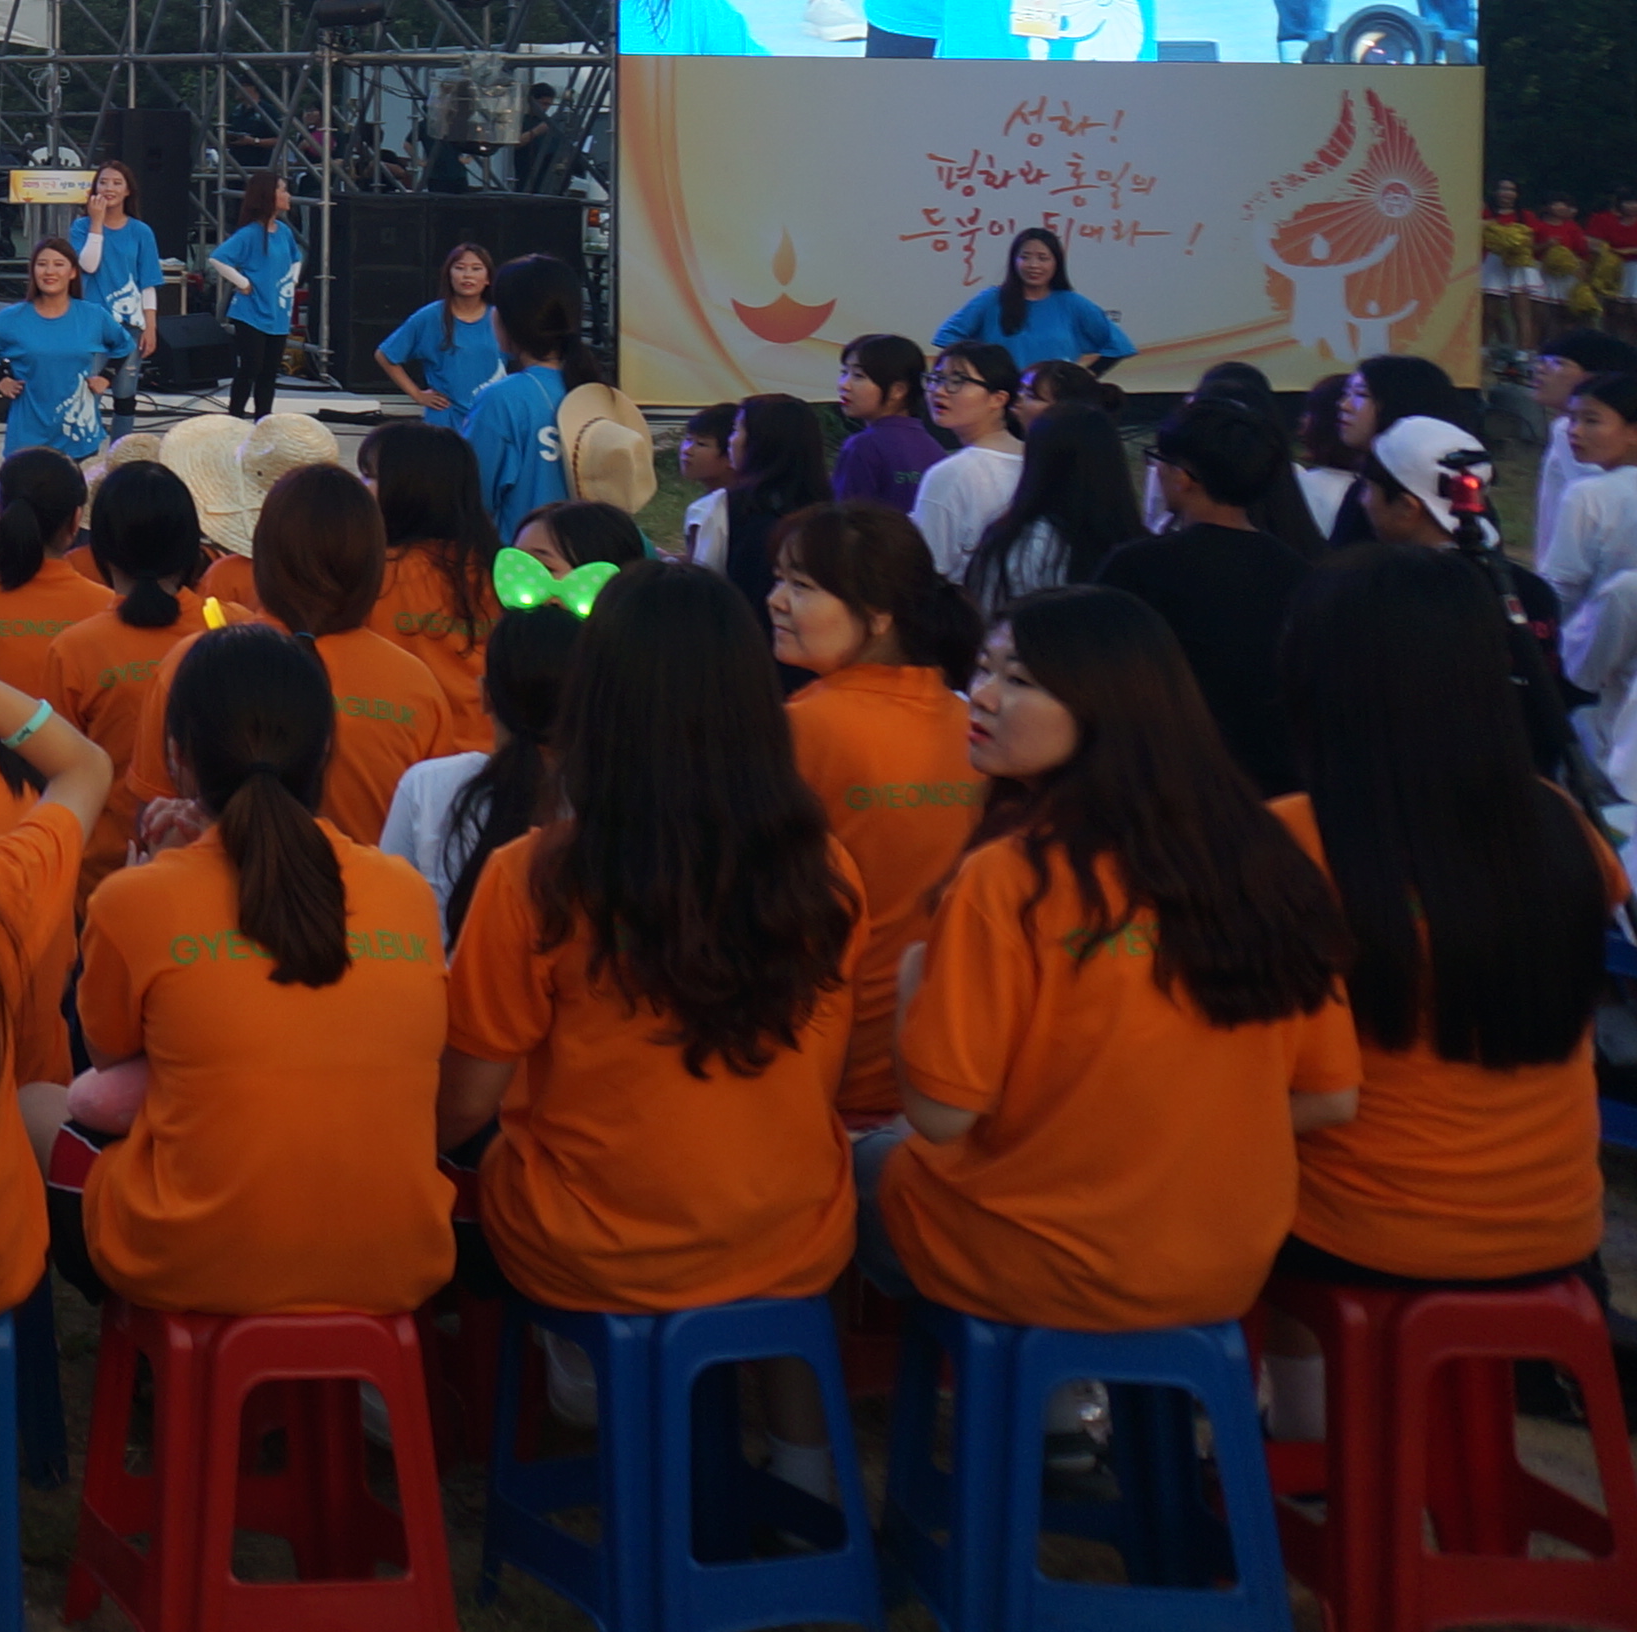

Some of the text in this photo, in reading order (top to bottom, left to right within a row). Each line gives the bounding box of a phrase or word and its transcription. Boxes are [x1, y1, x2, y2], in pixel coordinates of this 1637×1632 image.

[1002, 95, 1125, 147] 성화!
[926, 149, 1157, 210] 평화와 통일의
[898, 208, 1015, 287] 등불이
